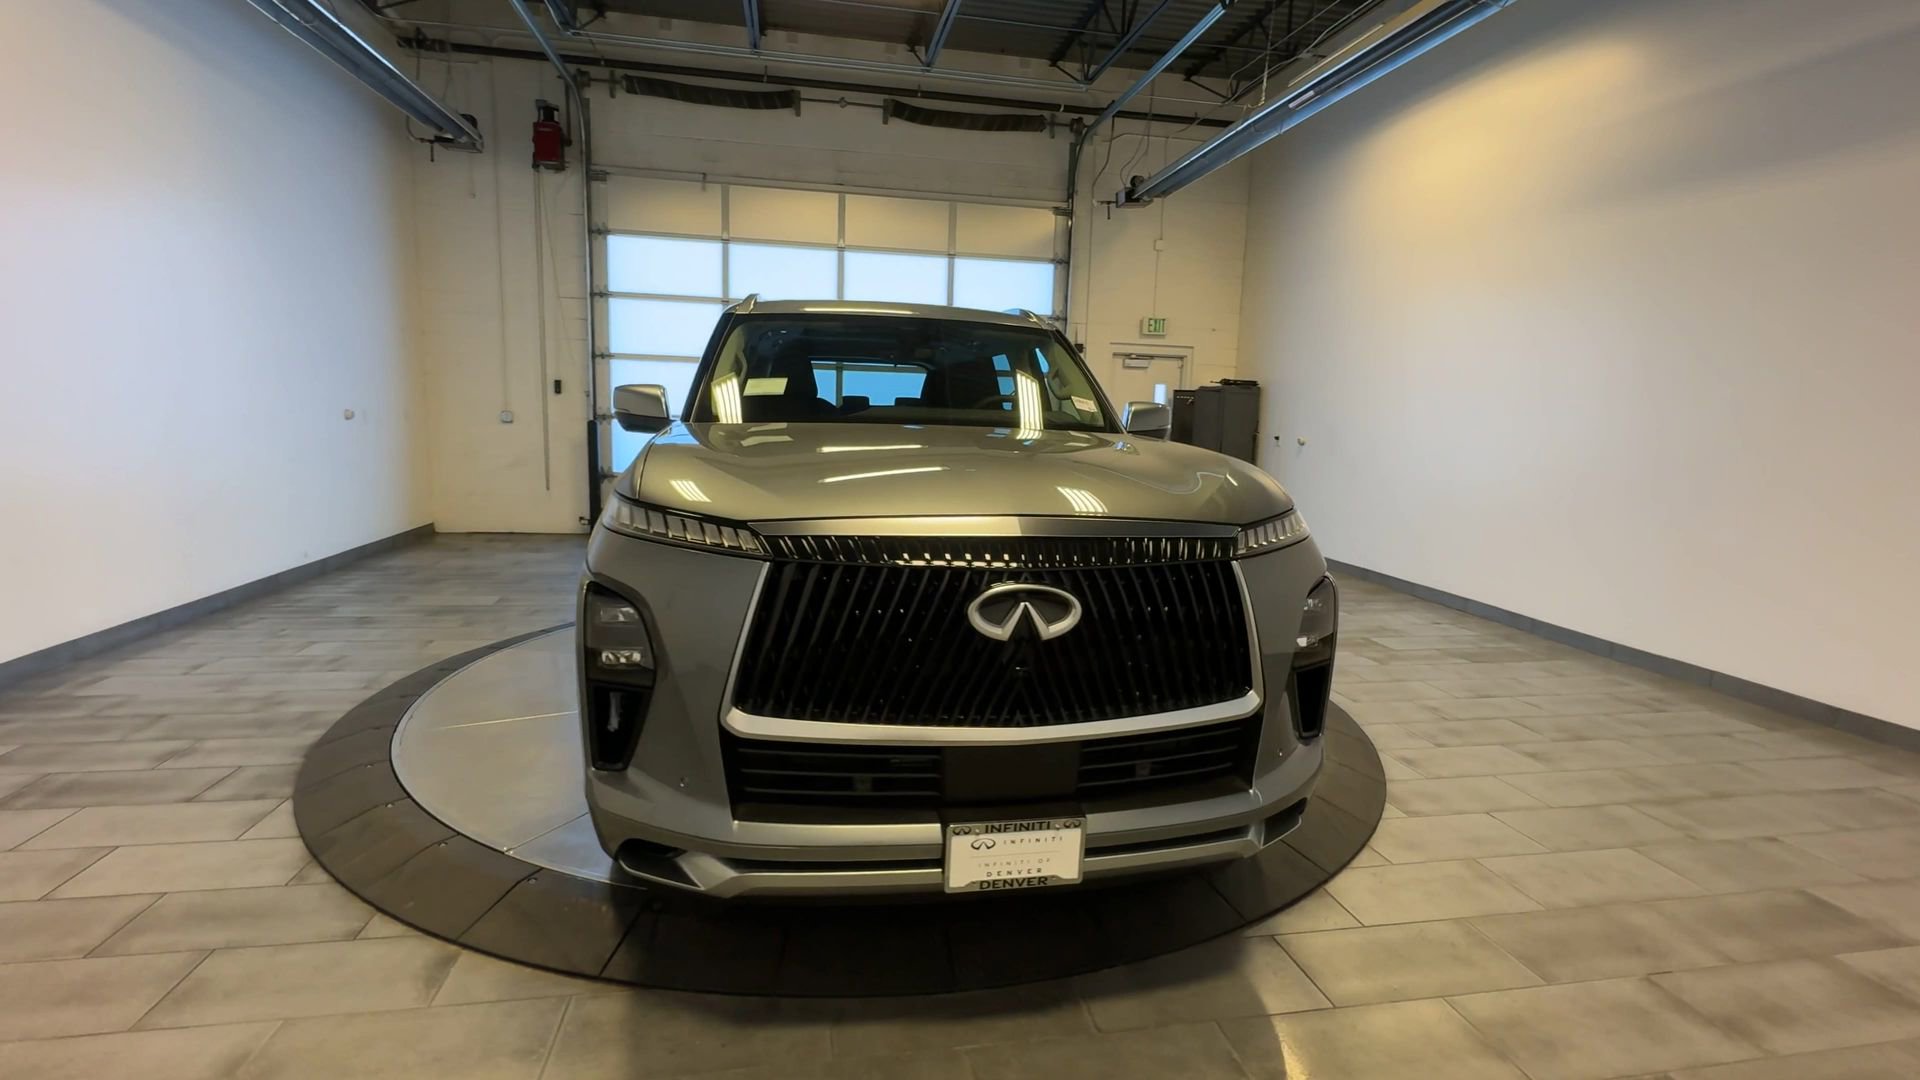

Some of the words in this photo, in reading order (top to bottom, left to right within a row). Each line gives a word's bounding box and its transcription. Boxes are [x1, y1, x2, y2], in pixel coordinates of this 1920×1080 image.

[1147, 318, 1166, 333] EXIT
[985, 821, 1051, 834] INFINITI
[1003, 836, 1063, 845] INFINITI
[986, 868, 1042, 878] DENVER
[979, 876, 1048, 890] DENVER
